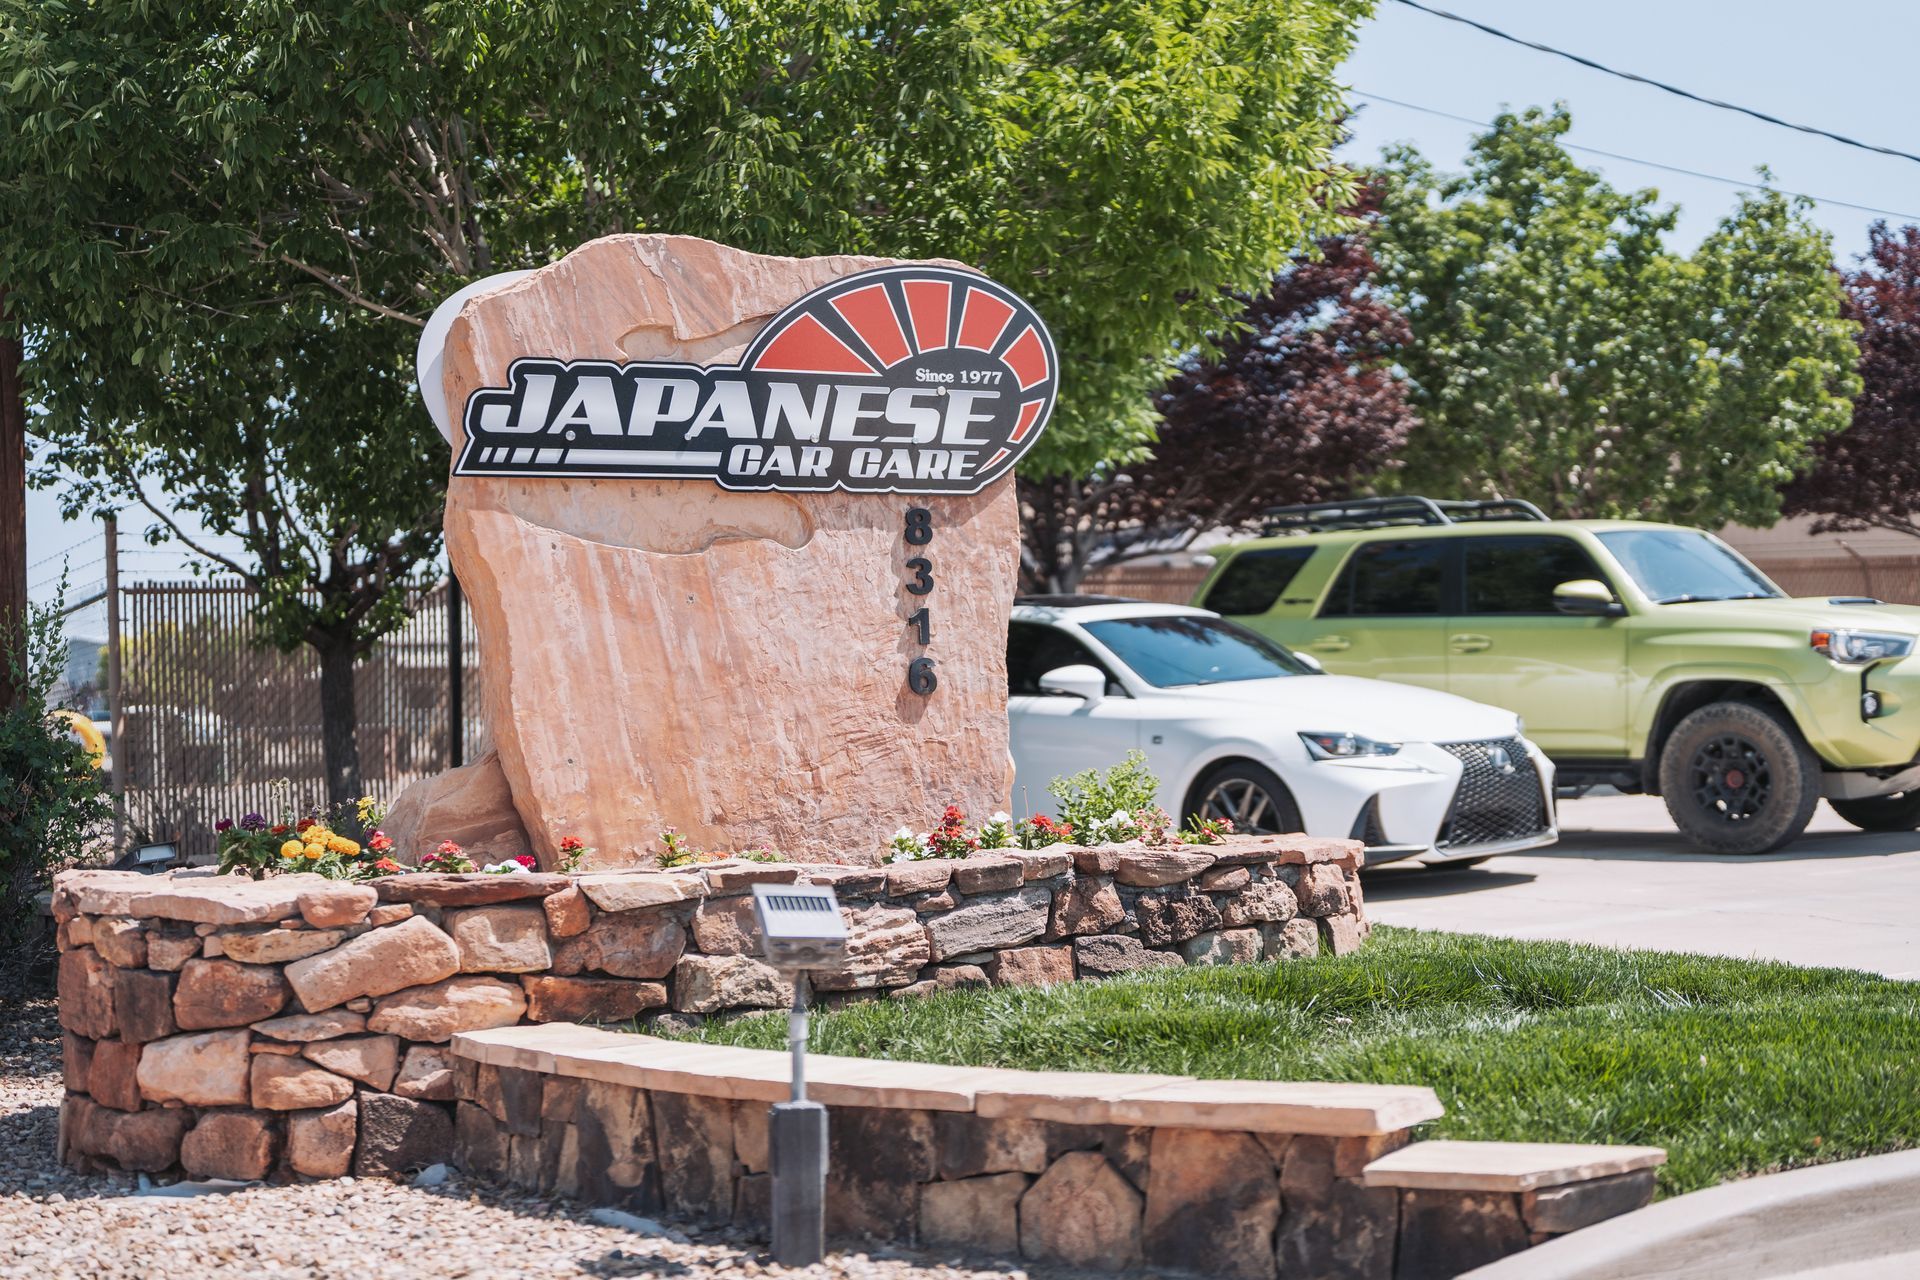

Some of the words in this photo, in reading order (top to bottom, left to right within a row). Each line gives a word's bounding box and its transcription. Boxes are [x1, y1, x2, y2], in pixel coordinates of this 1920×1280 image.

[915, 367, 955, 383] Since
[960, 369, 1003, 385] 1977
[479, 373, 1001, 445] JAPANESE
[727, 444, 834, 477] CAR
[848, 447, 980, 480] CARE
[904, 508, 937, 695] 8316
